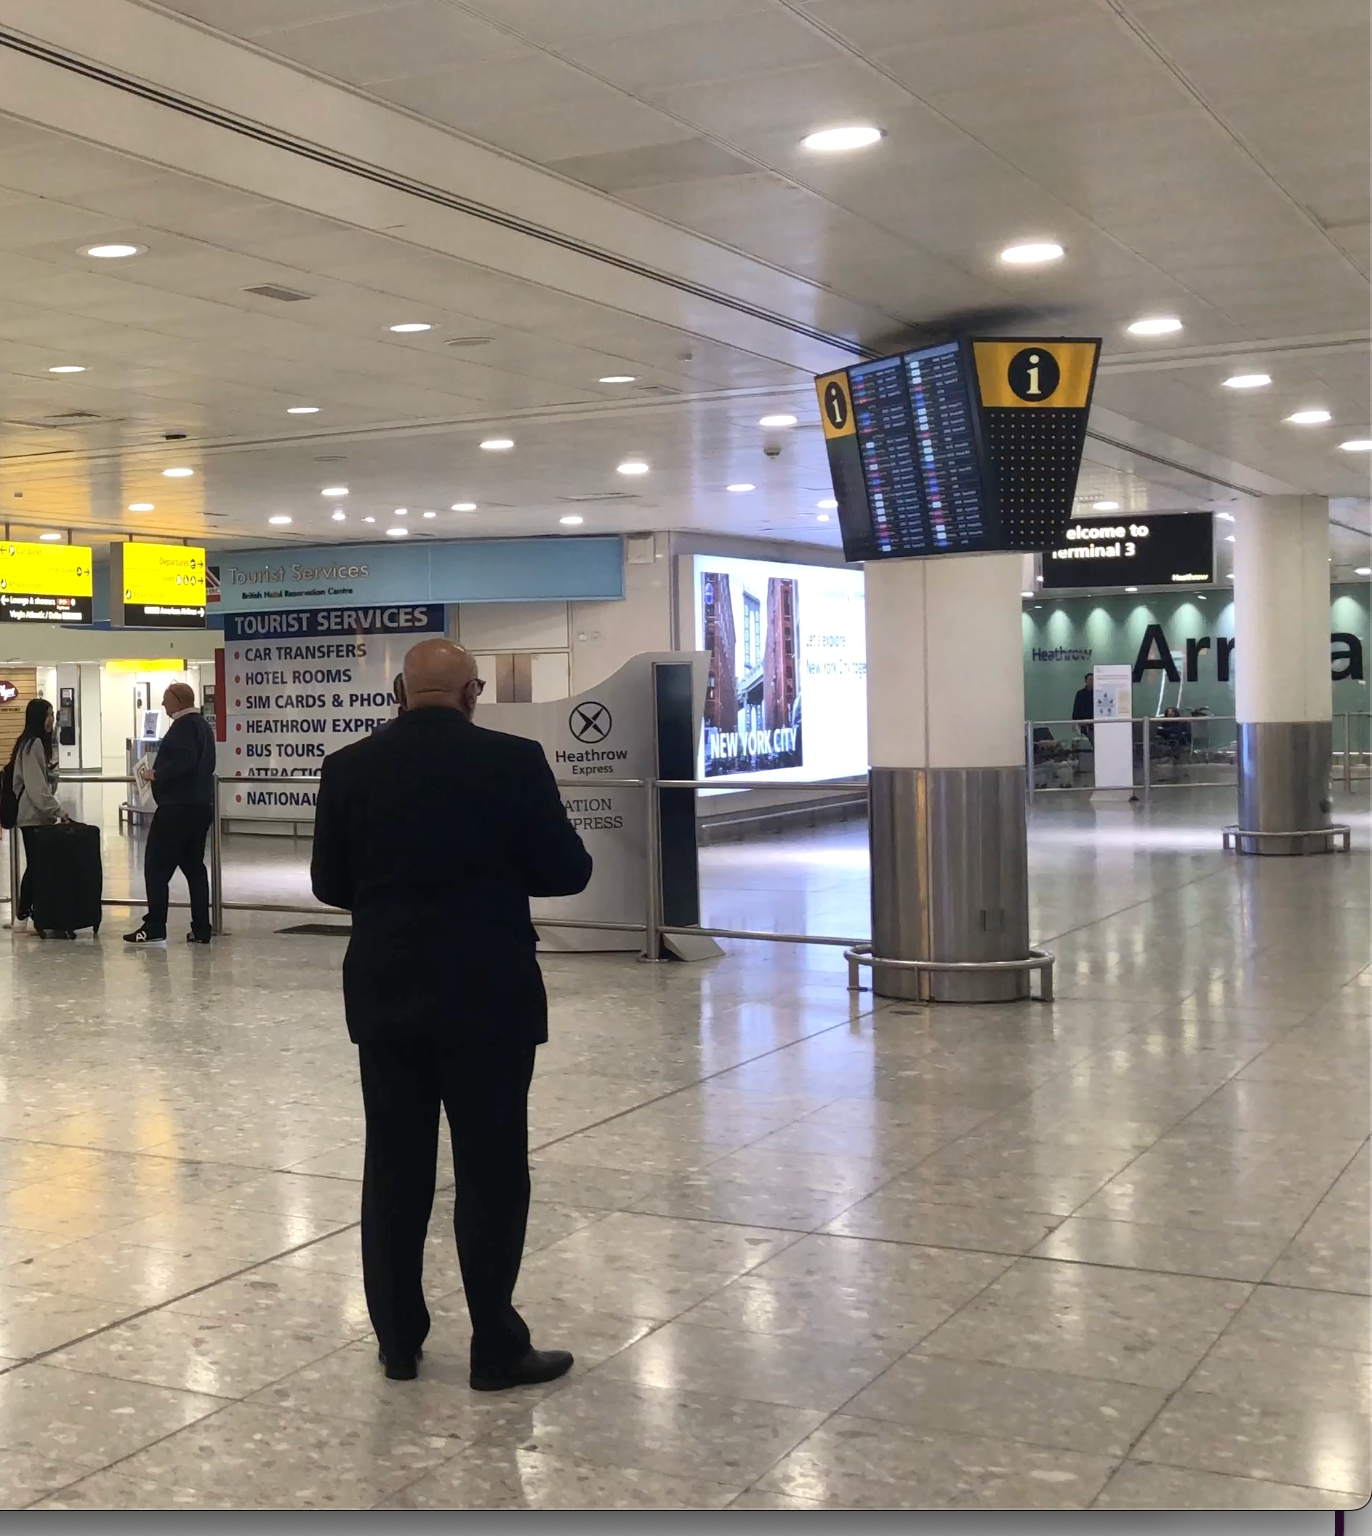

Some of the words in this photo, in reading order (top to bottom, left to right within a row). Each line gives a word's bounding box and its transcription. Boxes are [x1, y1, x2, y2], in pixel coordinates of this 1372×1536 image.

[1066, 525, 1125, 540] elcome
[1129, 524, 1149, 537] to
[1125, 542, 1136, 557] 3
[228, 565, 285, 585] Tourist
[291, 563, 370, 581] Services
[264, 590, 283, 598] Hotel
[284, 588, 326, 597] Reservation
[327, 587, 354, 595] Centre
[235, 612, 310, 635] TOURIST
[316, 607, 429, 631] SERVICES
[245, 647, 272, 661] CAR
[275, 643, 367, 661] TRANSFERS
[1032, 646, 1093, 662] Heathrow
[245, 671, 288, 686] HOTEL
[292, 669, 352, 685] ROOMS
[246, 695, 271, 709] SIM
[274, 694, 326, 709] CARDS
[331, 694, 344, 707] &
[349, 692, 395, 707] PHON
[246, 719, 326, 734] HEATHROW
[246, 744, 272, 758] BUS
[275, 743, 325, 758] TOURS
[711, 732, 738, 759] NEW
[740, 729, 772, 756] YORK
[773, 727, 797, 753] CITY
[555, 749, 628, 763] Heathrow
[572, 765, 613, 776] Express
[247, 792, 317, 806] NATIONAL
[565, 798, 612, 813] ATION
[569, 816, 623, 830] PRESS
